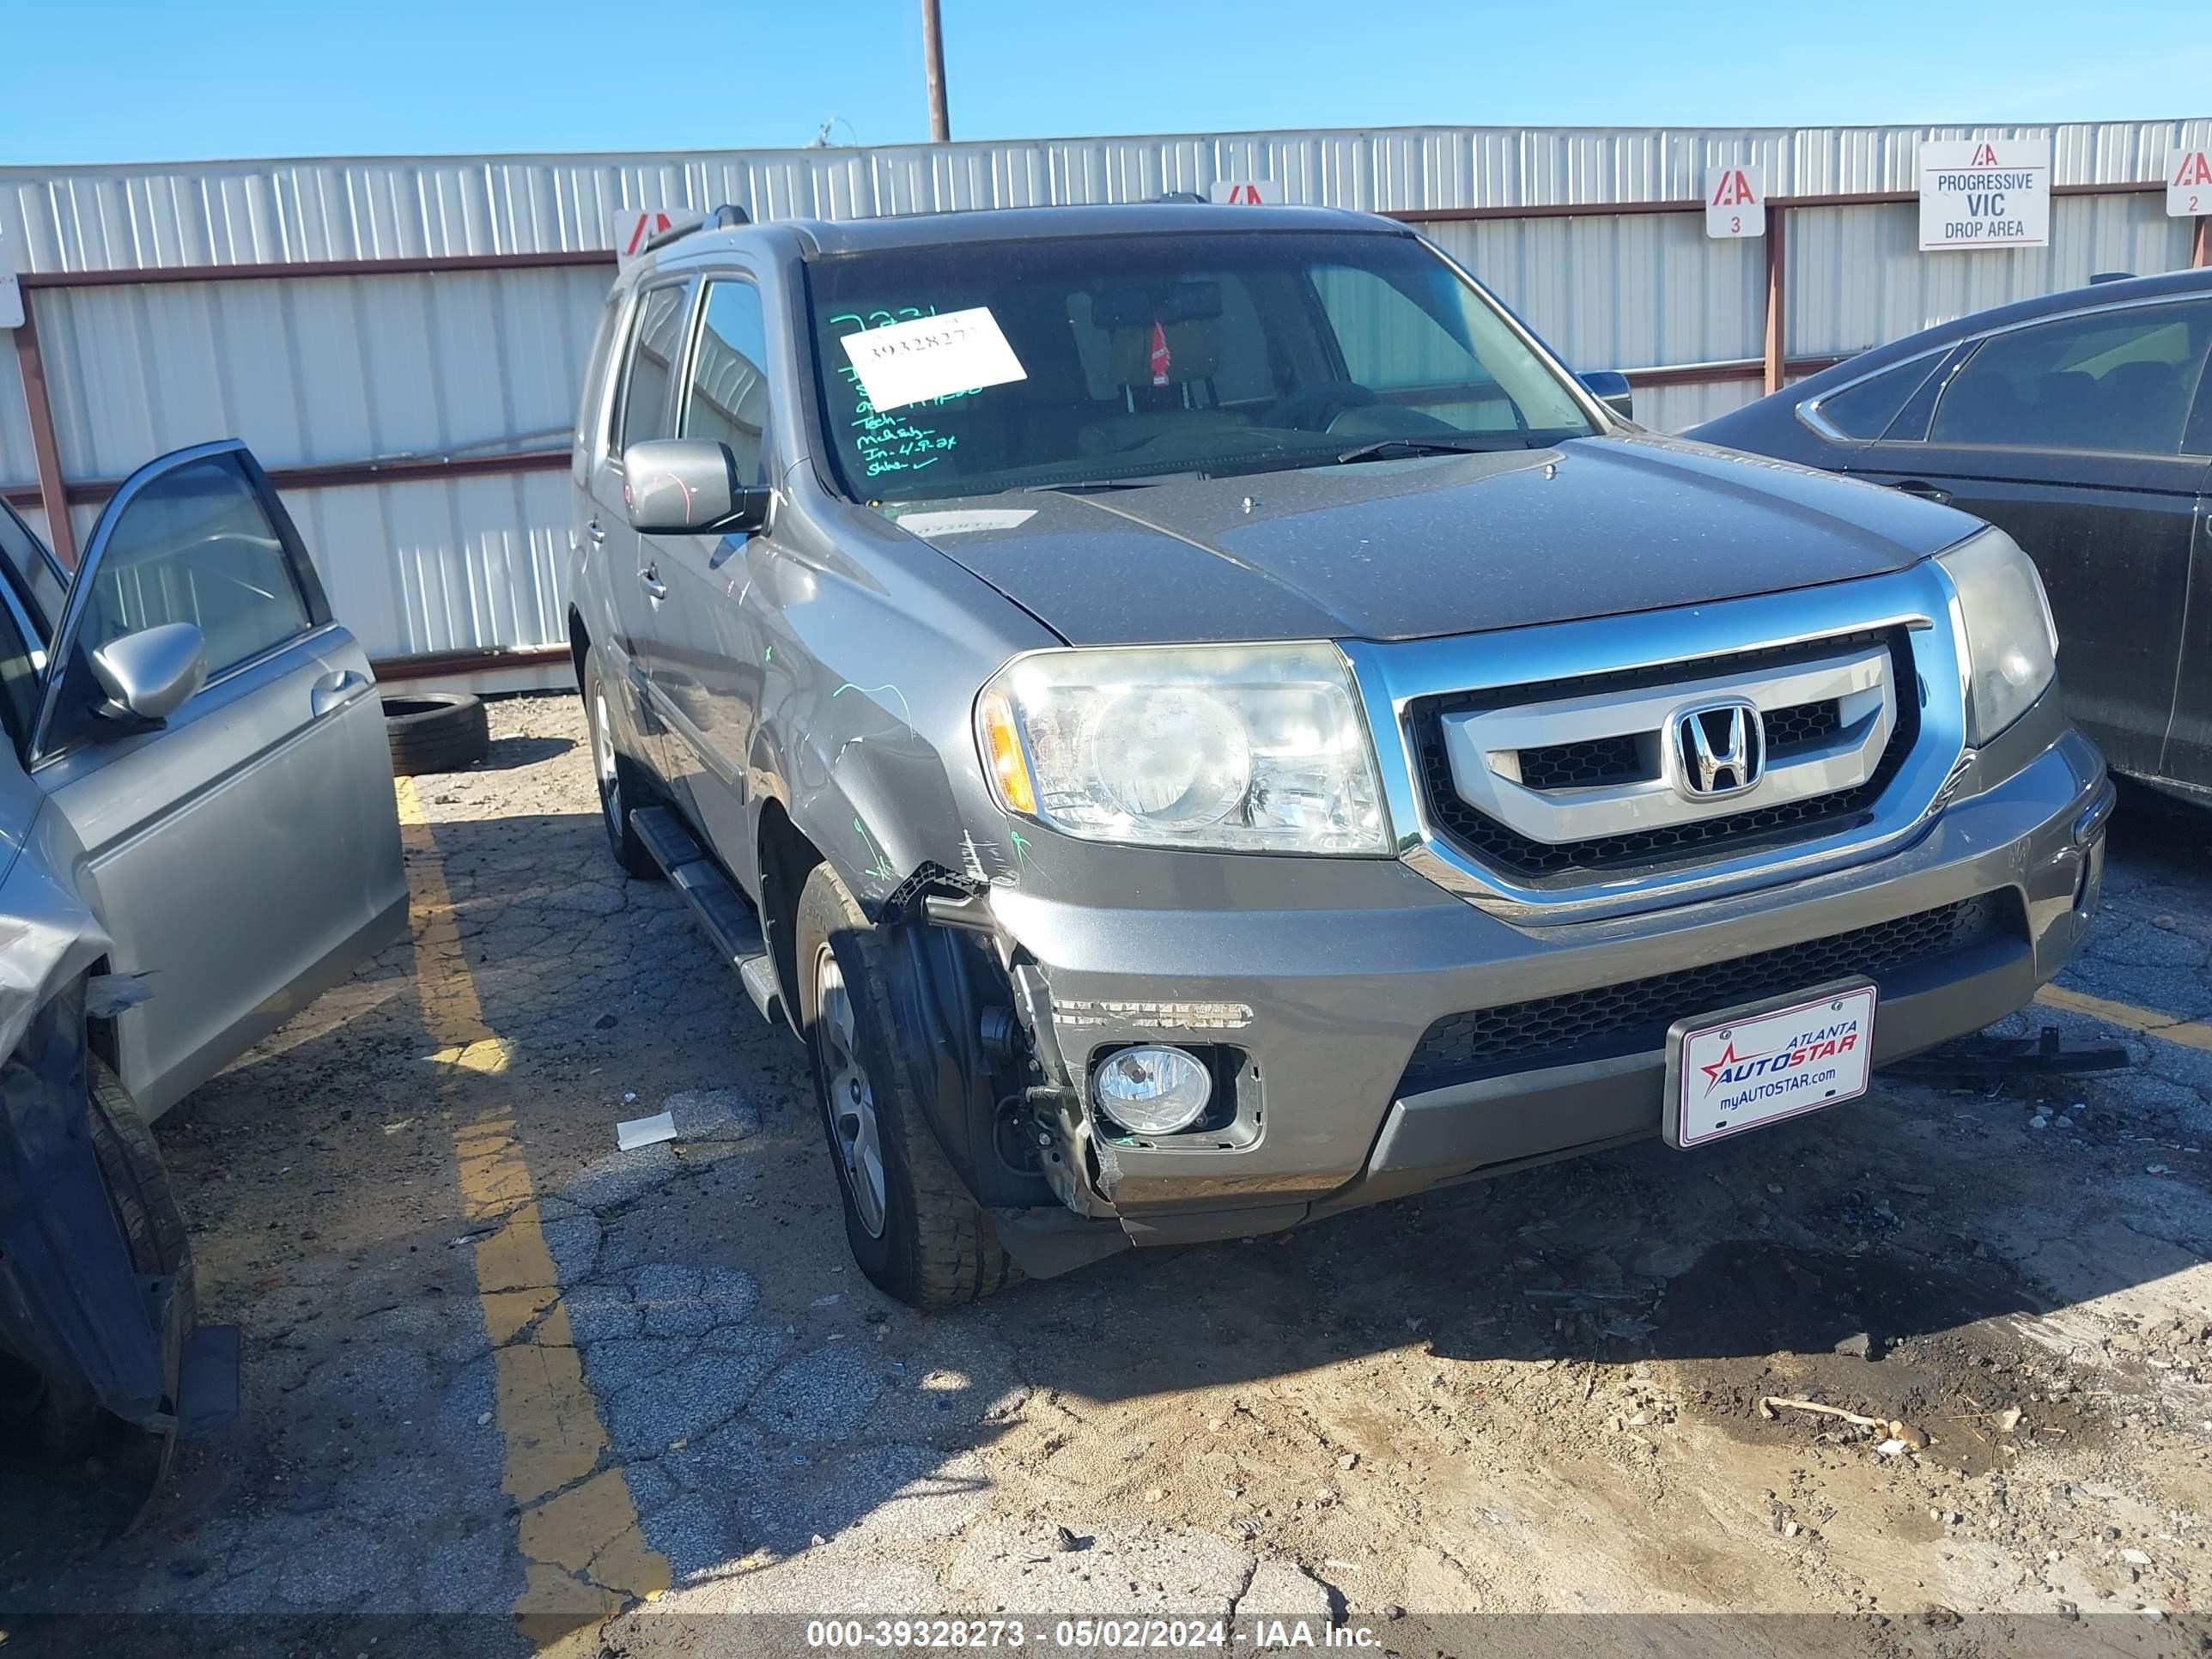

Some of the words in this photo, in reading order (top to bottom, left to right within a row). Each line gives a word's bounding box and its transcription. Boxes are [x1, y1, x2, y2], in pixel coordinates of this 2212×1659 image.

[1938, 173, 2033, 191] PROGRESSIVE
[1967, 192, 2005, 216] VIC
[2189, 195, 2199, 212] 2
[1730, 216, 1741, 234] 3
[1945, 222, 1983, 239] DROP
[1987, 220, 2025, 237] AREA
[1785, 1020, 1856, 1051] ATLANTA
[1717, 1034, 1858, 1084] AUTOSTAR
[1720, 1068, 1836, 1110] myAUTOSTAR.com
